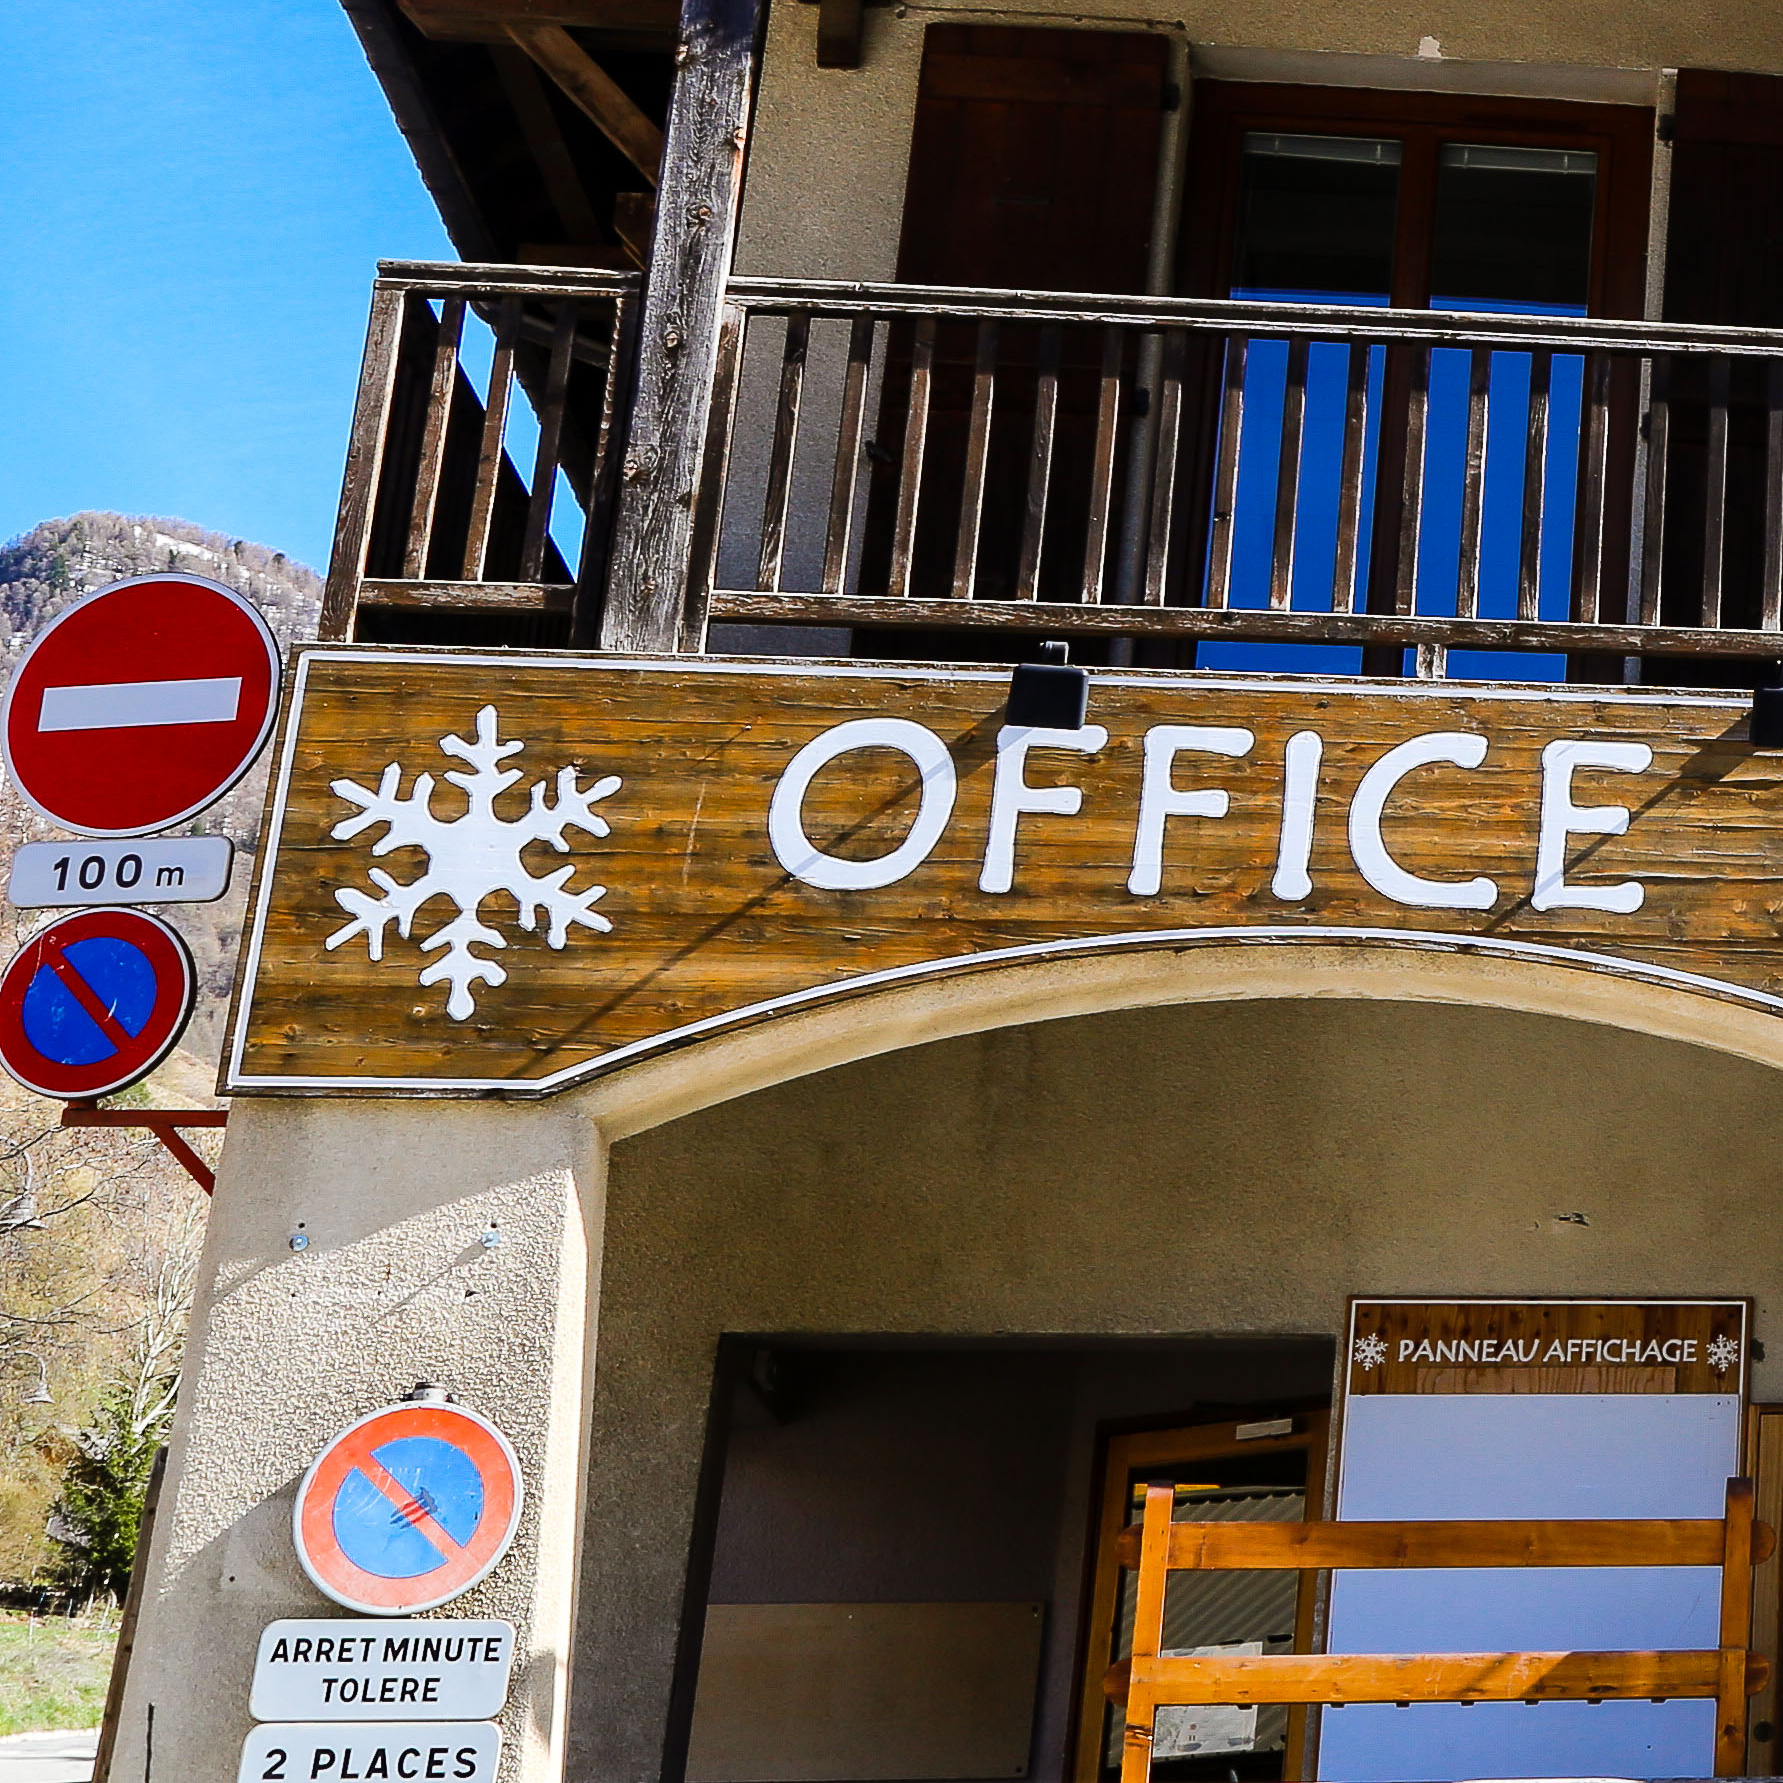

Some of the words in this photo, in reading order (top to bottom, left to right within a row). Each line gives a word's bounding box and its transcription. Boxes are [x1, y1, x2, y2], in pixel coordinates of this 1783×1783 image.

[768, 715, 1646, 914] OFFICE
[53, 853, 143, 891] 100
[155, 865, 185, 887] m
[1398, 1338, 1540, 1363] PANNEAU
[1542, 1338, 1699, 1363] AFFICHAGE
[269, 1637, 376, 1663] ARRET
[382, 1637, 503, 1663] MINUTE
[322, 1677, 441, 1703] TOLERE
[261, 1747, 288, 1781] 2
[309, 1746, 478, 1781] PLACES
